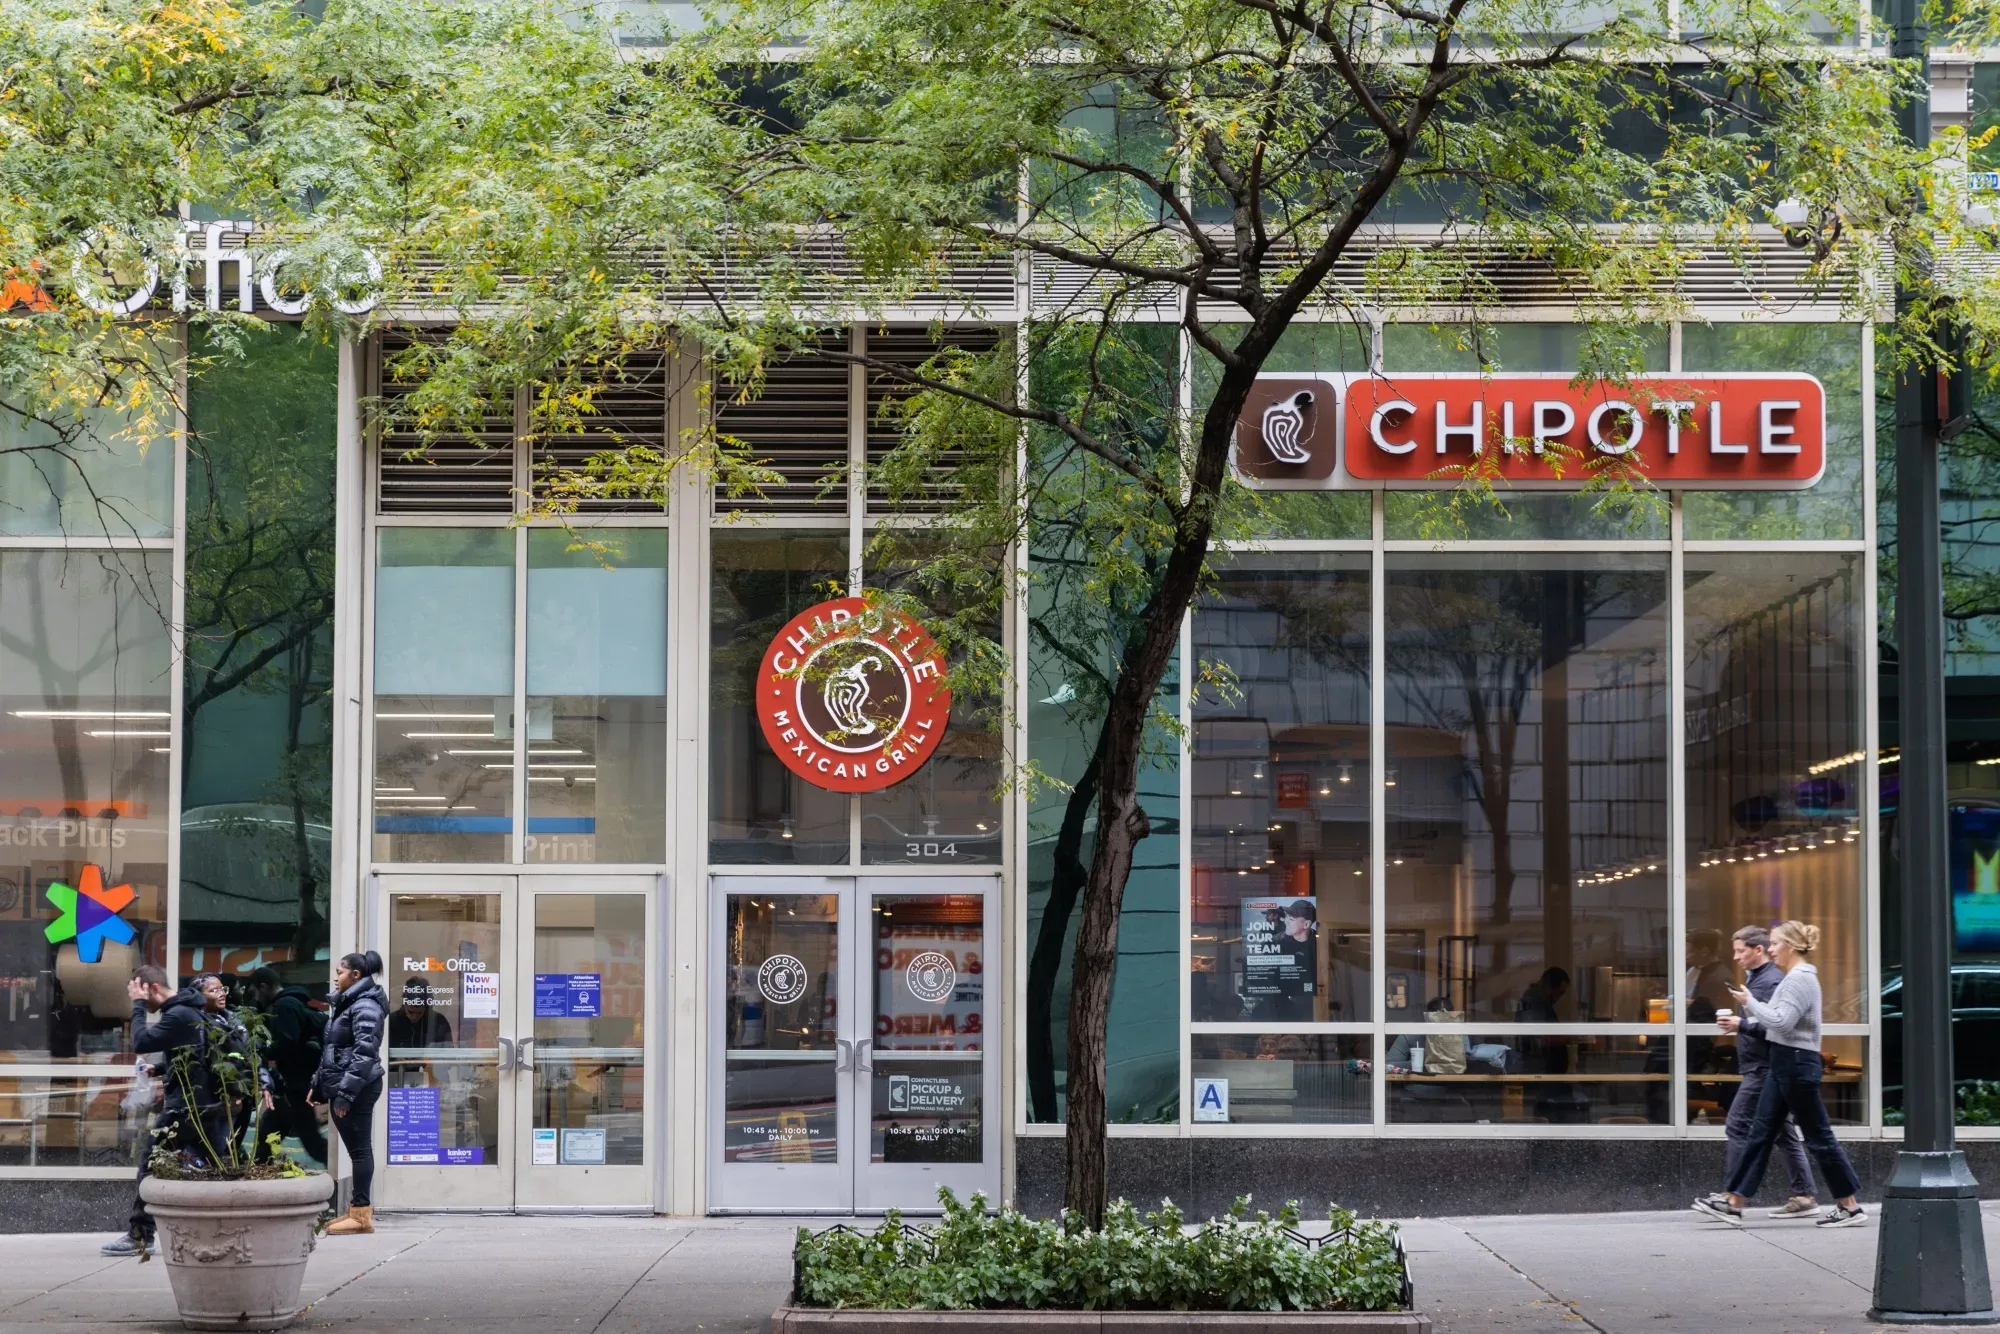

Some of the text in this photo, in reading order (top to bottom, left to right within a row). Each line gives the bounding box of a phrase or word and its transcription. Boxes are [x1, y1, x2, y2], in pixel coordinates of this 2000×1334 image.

[1369, 399, 1803, 455] CHIPOTLE
[773, 608, 939, 684] CHIPOTLE
[773, 709, 933, 778] MEXICAN GRILL
[59, 820, 128, 849] Plus
[524, 835, 593, 862] Print
[905, 842, 958, 857] 304
[1246, 921, 1275, 931] JOIN
[1246, 933, 1273, 943] OUR
[1246, 944, 1281, 954] TEAM
[403, 956, 487, 972] FedEx Office
[762, 957, 804, 976] CHIPOTLE
[910, 954, 952, 974] CHIPOTLE
[466, 974, 491, 984] Now
[402, 985, 454, 996] FedEx Express
[465, 985, 497, 996] hiring
[762, 982, 803, 1000] MEXICAN GRILL
[911, 980, 936, 997] MEXICAN
[936, 981, 951, 996] GRILL
[402, 997, 453, 1006] FedEx Ground
[911, 1084, 962, 1095] PICKUP &
[1199, 1083, 1223, 1110] A
[910, 1095, 965, 1106] DELIVERY
[889, 1127, 912, 1135] 10:45
[931, 1127, 954, 1135] 10:00
